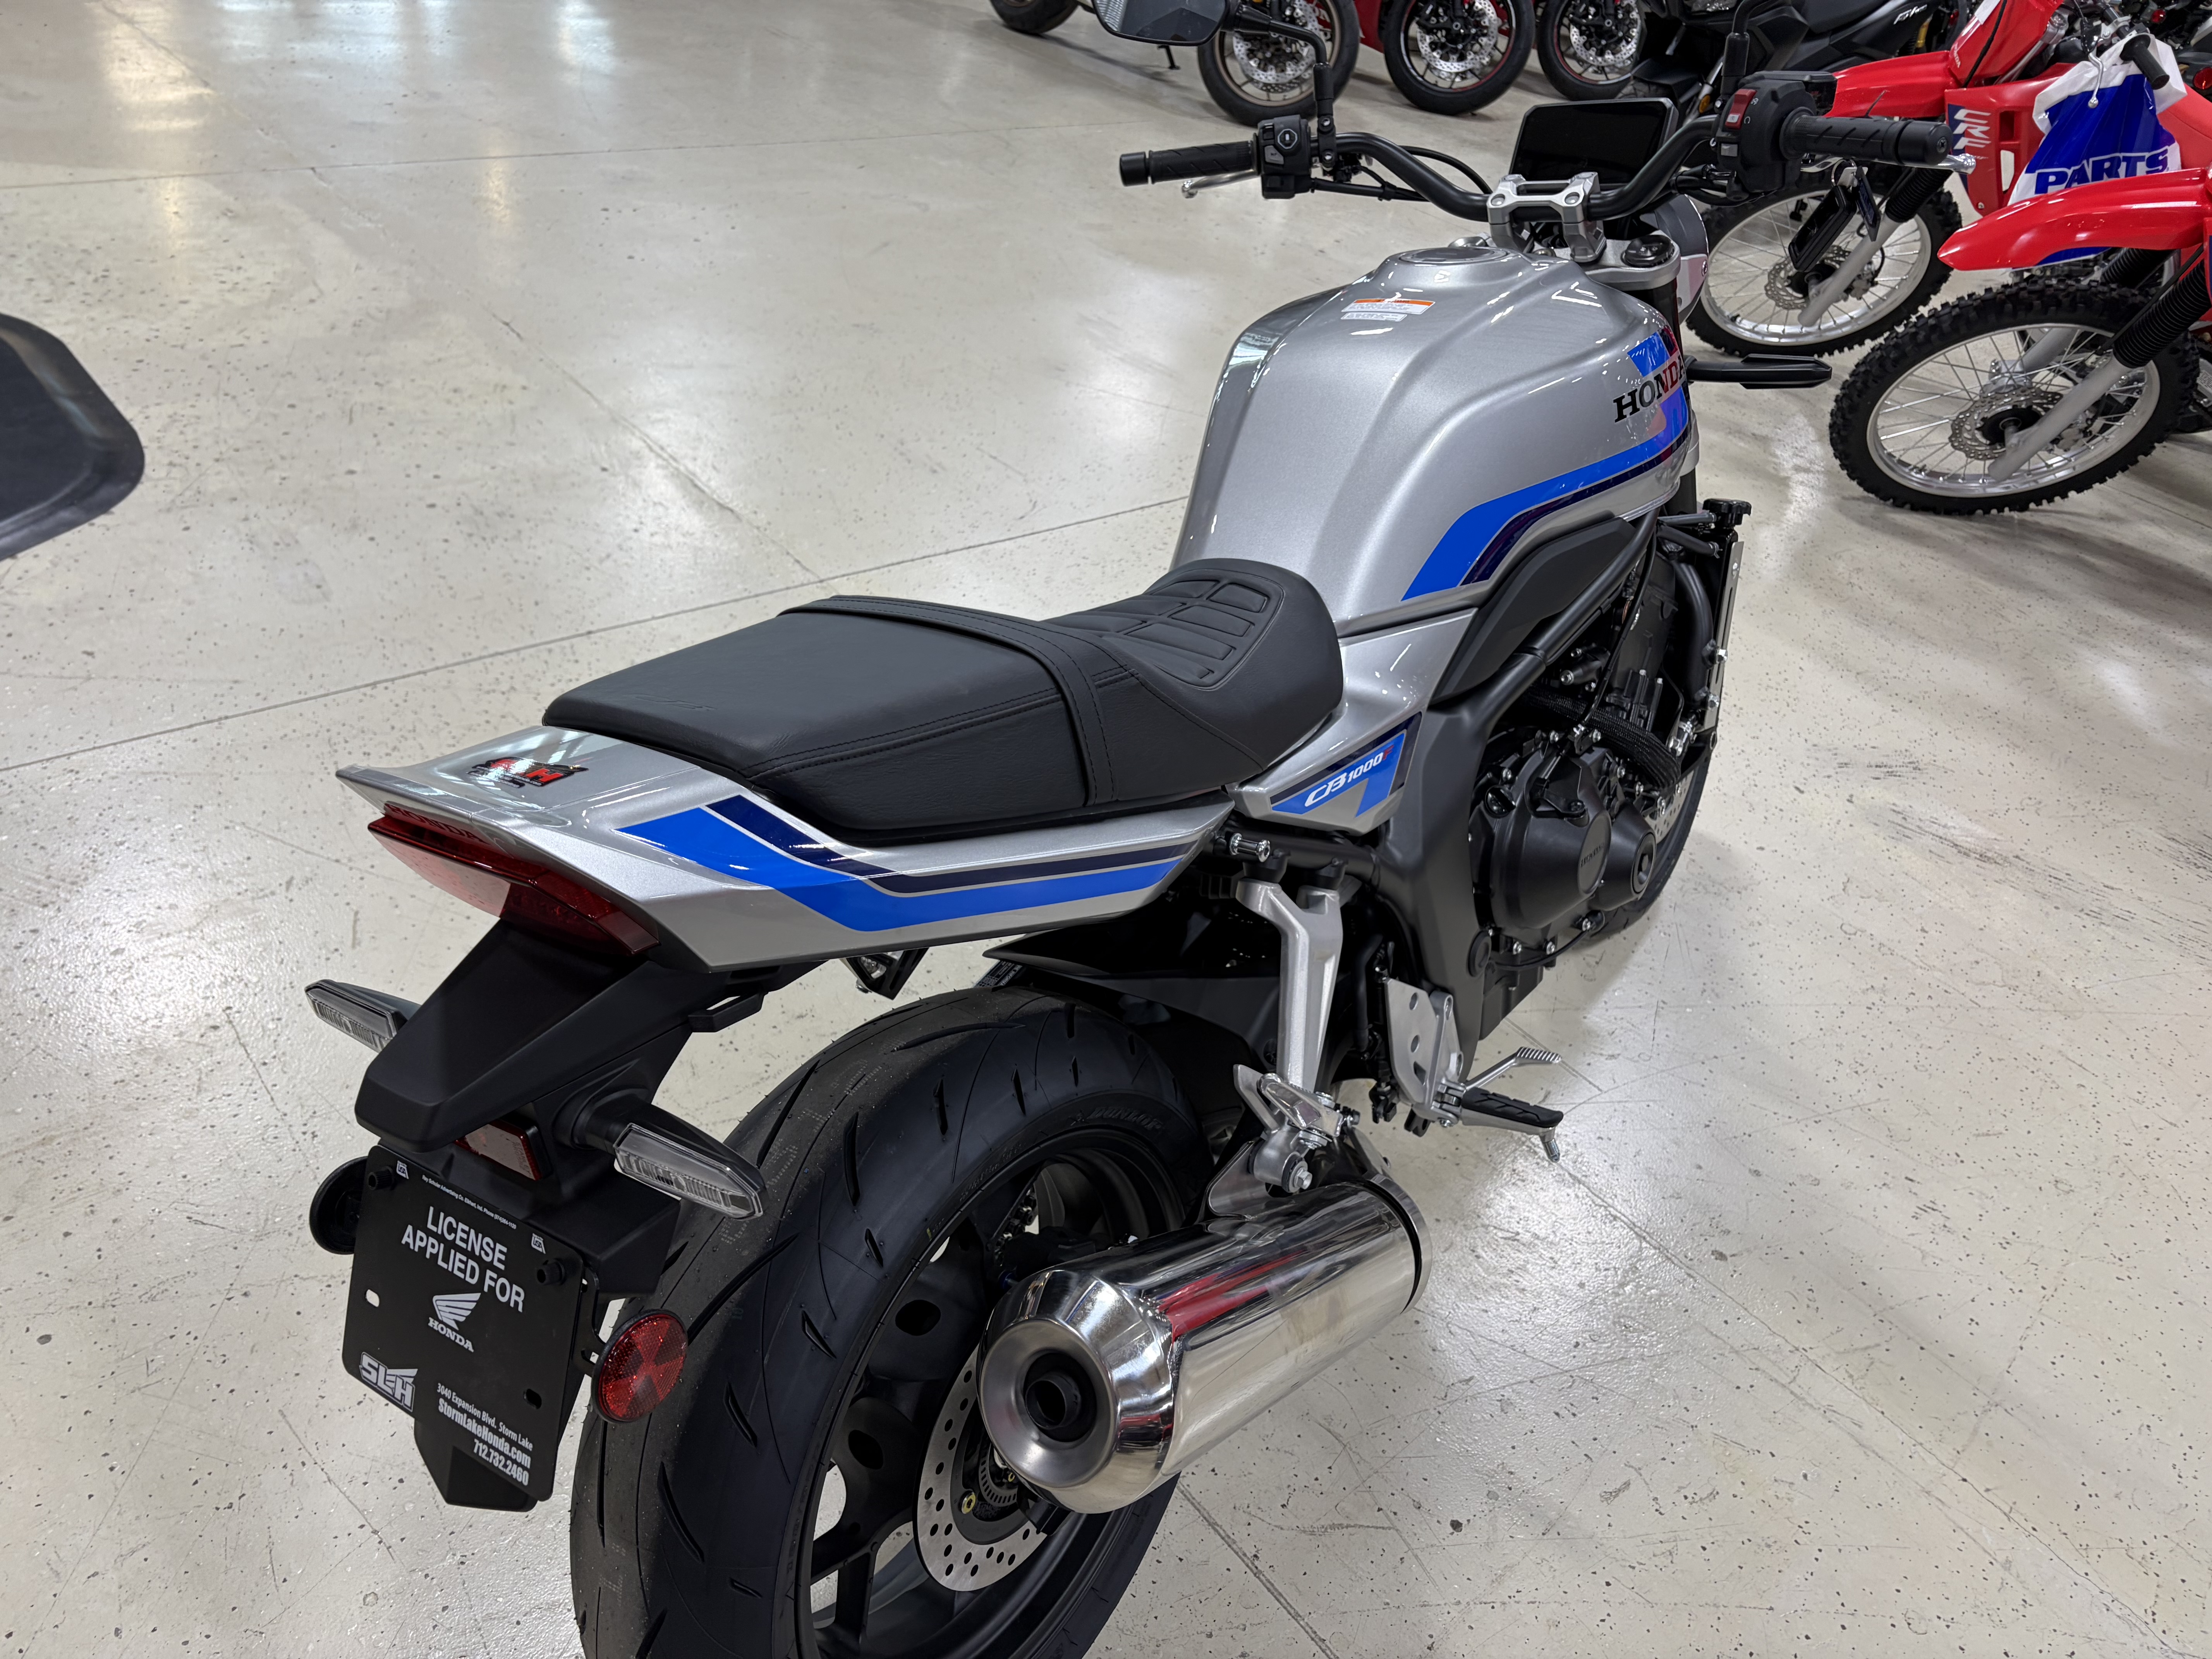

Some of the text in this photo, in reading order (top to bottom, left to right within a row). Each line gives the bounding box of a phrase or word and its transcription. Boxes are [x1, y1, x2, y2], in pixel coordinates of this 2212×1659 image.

[1953, 108, 1991, 150] CRF
[2034, 149, 2169, 194] PARTS
[385, 803, 491, 845] HONDA
[1086, 1106, 1163, 1130] DUNLOP
[427, 1206, 507, 1271] LICENSE
[401, 1224, 525, 1313] APPLIED FOR
[428, 1317, 474, 1352] HONDA
[436, 1382, 533, 1451] 3040 Expansion Blvd. Storm Lake
[438, 1397, 531, 1469] StormLakeHonda.com
[473, 1439, 529, 1486] 712.732.2460
